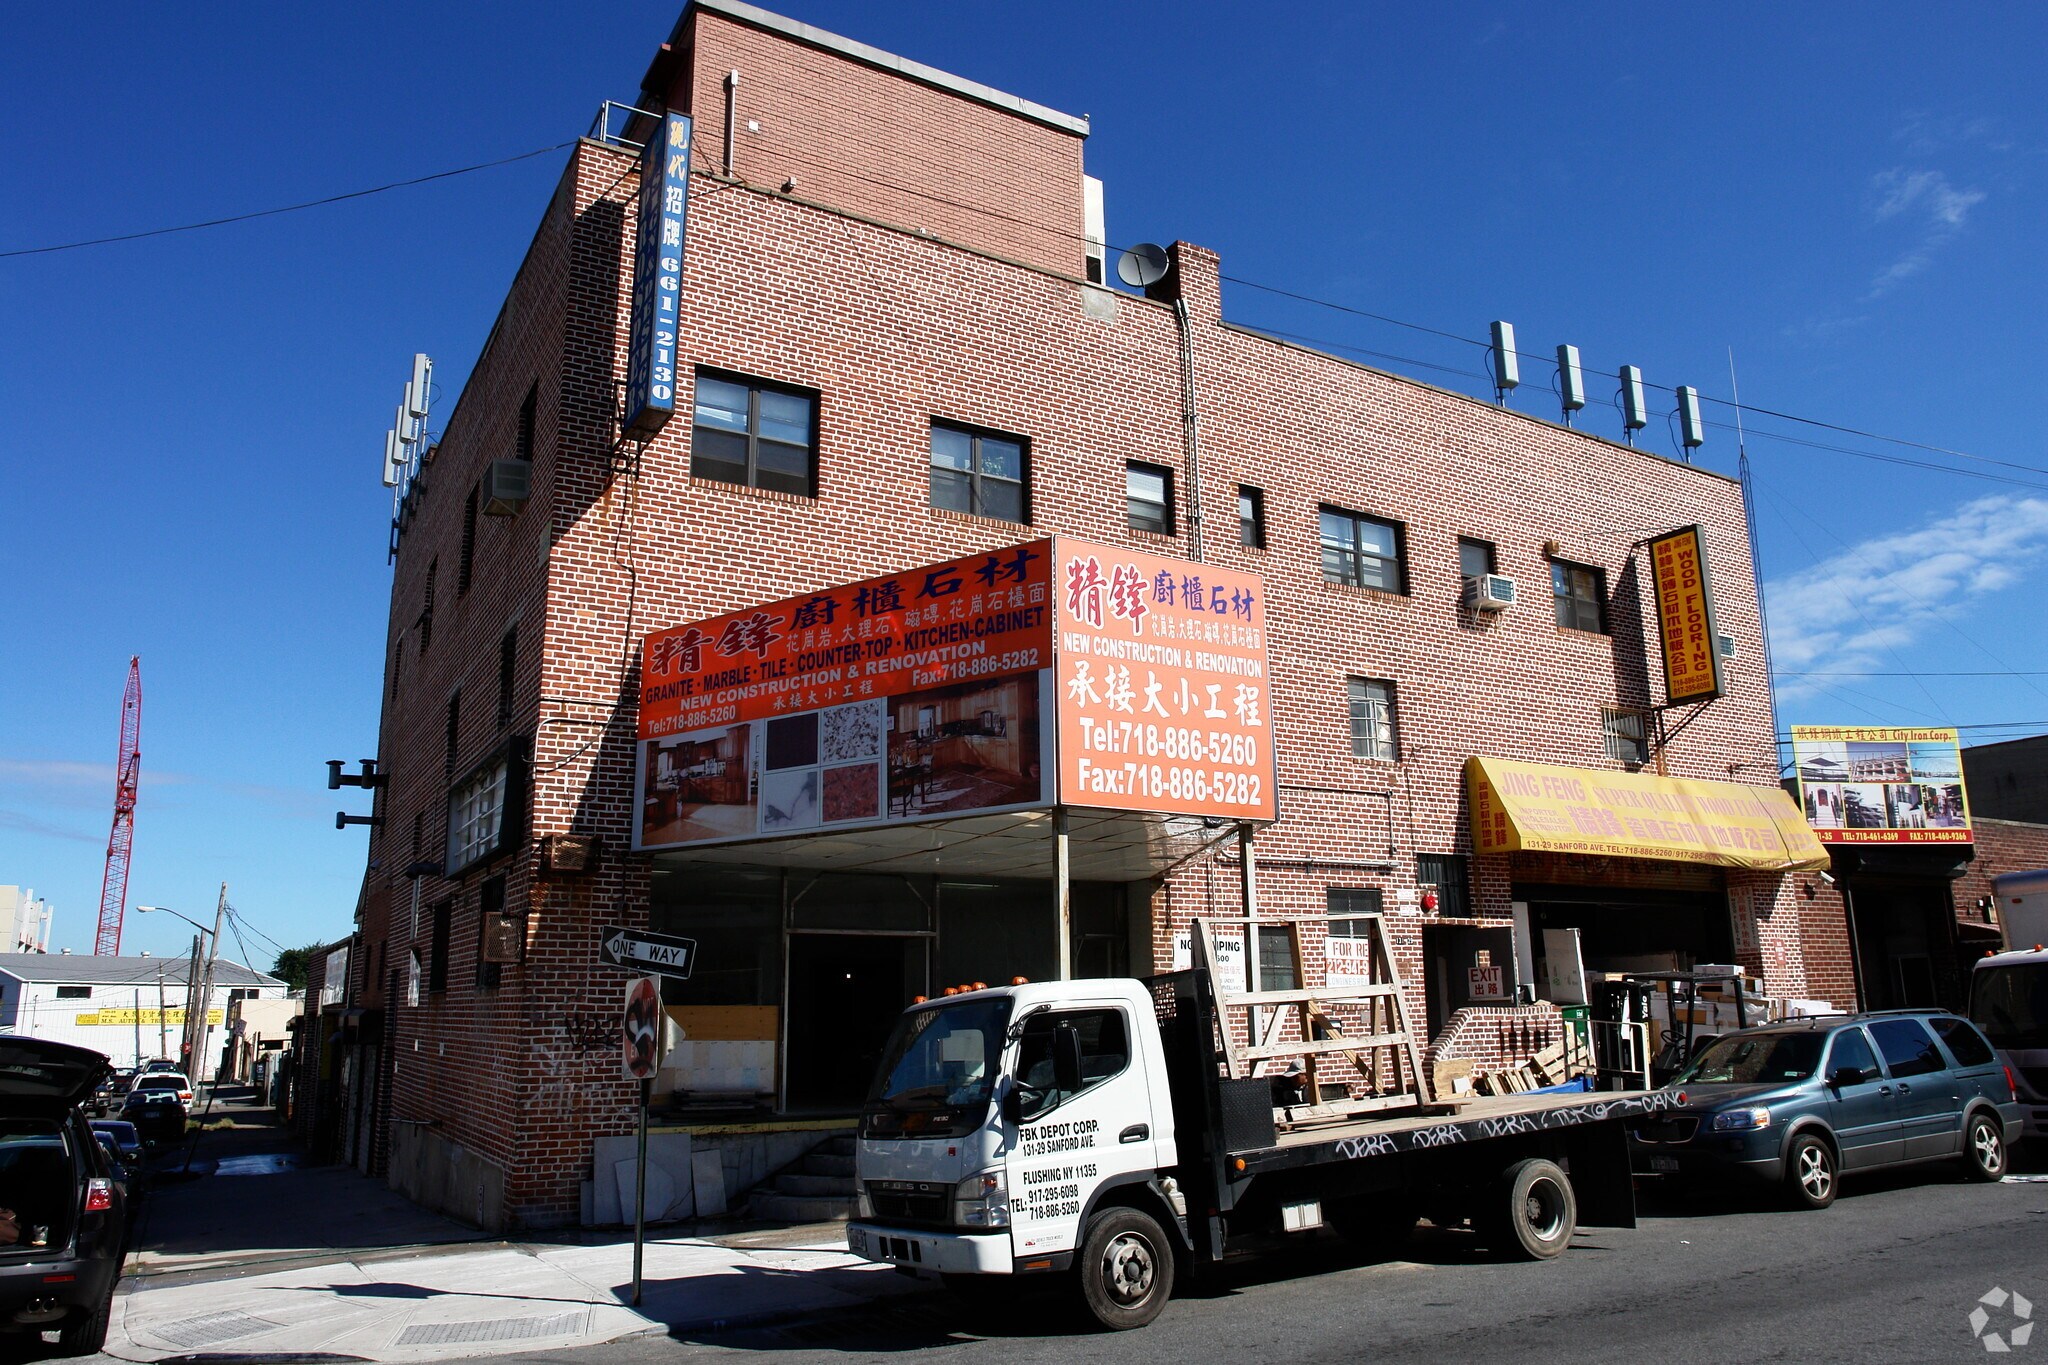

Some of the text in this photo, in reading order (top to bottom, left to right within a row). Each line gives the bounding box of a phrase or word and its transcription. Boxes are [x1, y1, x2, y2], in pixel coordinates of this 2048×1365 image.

[652, 257, 680, 400] 661-2130
[1678, 549, 1697, 589] WOOD
[1685, 593, 1708, 672] FLOORING
[646, 606, 1045, 704] GRANITE MARBLE TILE COUNTER-TOP KITCHEN-CABINET
[1063, 632, 1262, 679] NEW CONSTRUCTION & RENOVATION
[680, 640, 986, 712] NEW CONSTRUCTION & RENOVATION
[773, 680, 873, 711] 承接大小工程
[1067, 660, 1263, 727] 承接大小工程
[1892, 729, 1908, 743] City
[1911, 729, 1928, 741] Iron
[1929, 730, 1952, 743] Corp.
[1501, 771, 1540, 798] JING
[1541, 775, 1587, 802] FENG
[1526, 840, 1553, 850] 131-29
[1553, 842, 1589, 852] SANFORD
[612, 939, 681, 964] ONE WAY
[1332, 941, 1369, 958] FOR RE
[1325, 958, 1370, 975] 212-941-9
[1470, 967, 1499, 982] EXIT
[1474, 982, 1498, 996] 出路
[1019, 1119, 1100, 1142] FBK DEPOT CORP.
[1022, 1134, 1096, 1157] 131-29 SANFORD AVE.
[1023, 1163, 1097, 1185] FLUSHING NY 11355
[882, 1181, 930, 1191] FUSO
[1010, 1198, 1028, 1213] TEL:
